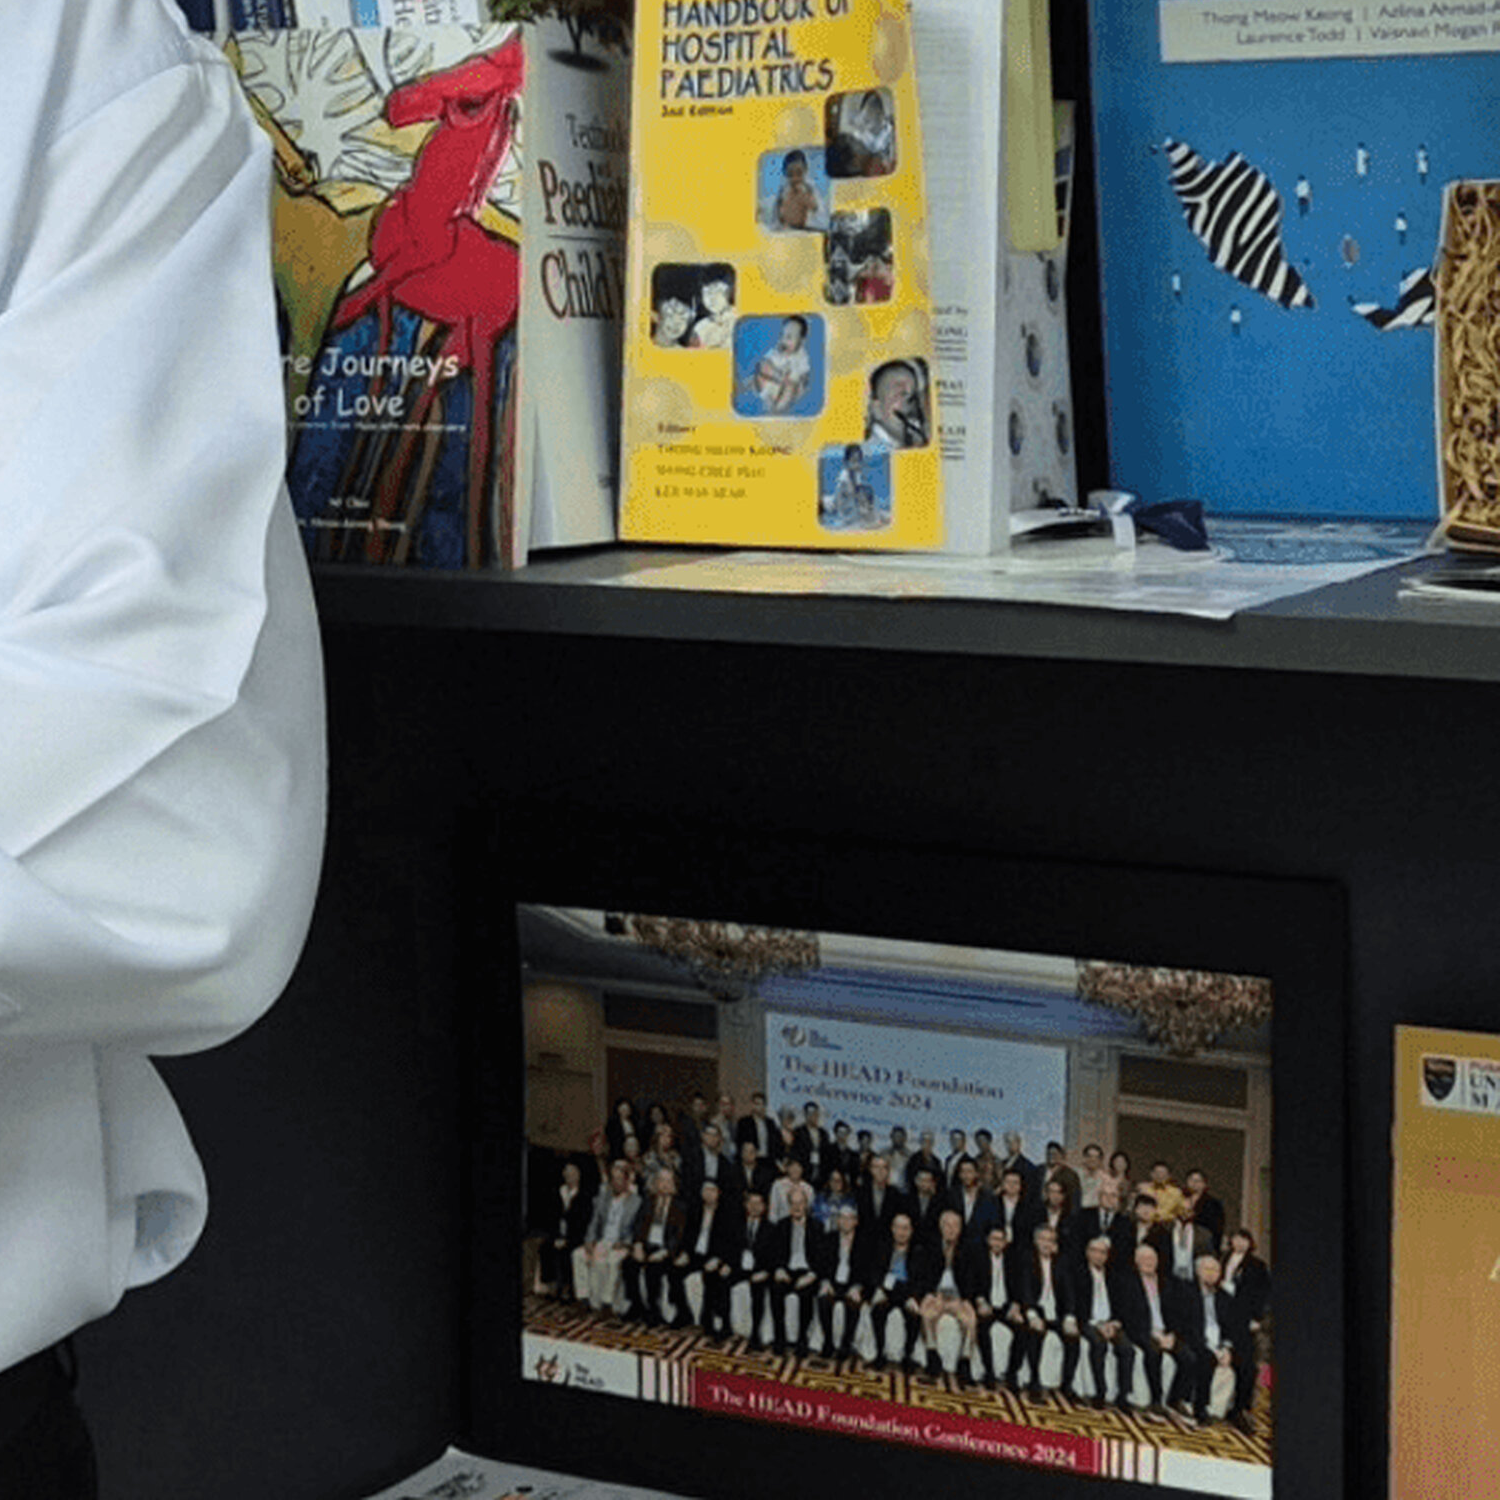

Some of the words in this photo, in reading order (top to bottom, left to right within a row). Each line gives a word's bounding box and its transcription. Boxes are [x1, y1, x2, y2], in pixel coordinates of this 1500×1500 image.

[662, 27, 795, 64] HOSPITAL
[660, 58, 834, 99] PAEDIATRICS
[540, 248, 614, 320] Child
[281, 354, 311, 374] re
[321, 347, 460, 387] Journeys
[294, 385, 327, 416] of
[337, 388, 404, 416] Love
[780, 1076, 882, 1107] Conference
[888, 1093, 932, 1111] 2024
[781, 1053, 816, 1075] The
[822, 1060, 891, 1084] HEAD
[896, 1068, 1004, 1100] Foundation
[707, 1385, 743, 1408] The
[748, 1391, 812, 1421] HEAD
[815, 1405, 920, 1441] Foundation
[924, 1423, 1029, 1460] Conference
[1032, 1443, 1077, 1468] 2024
